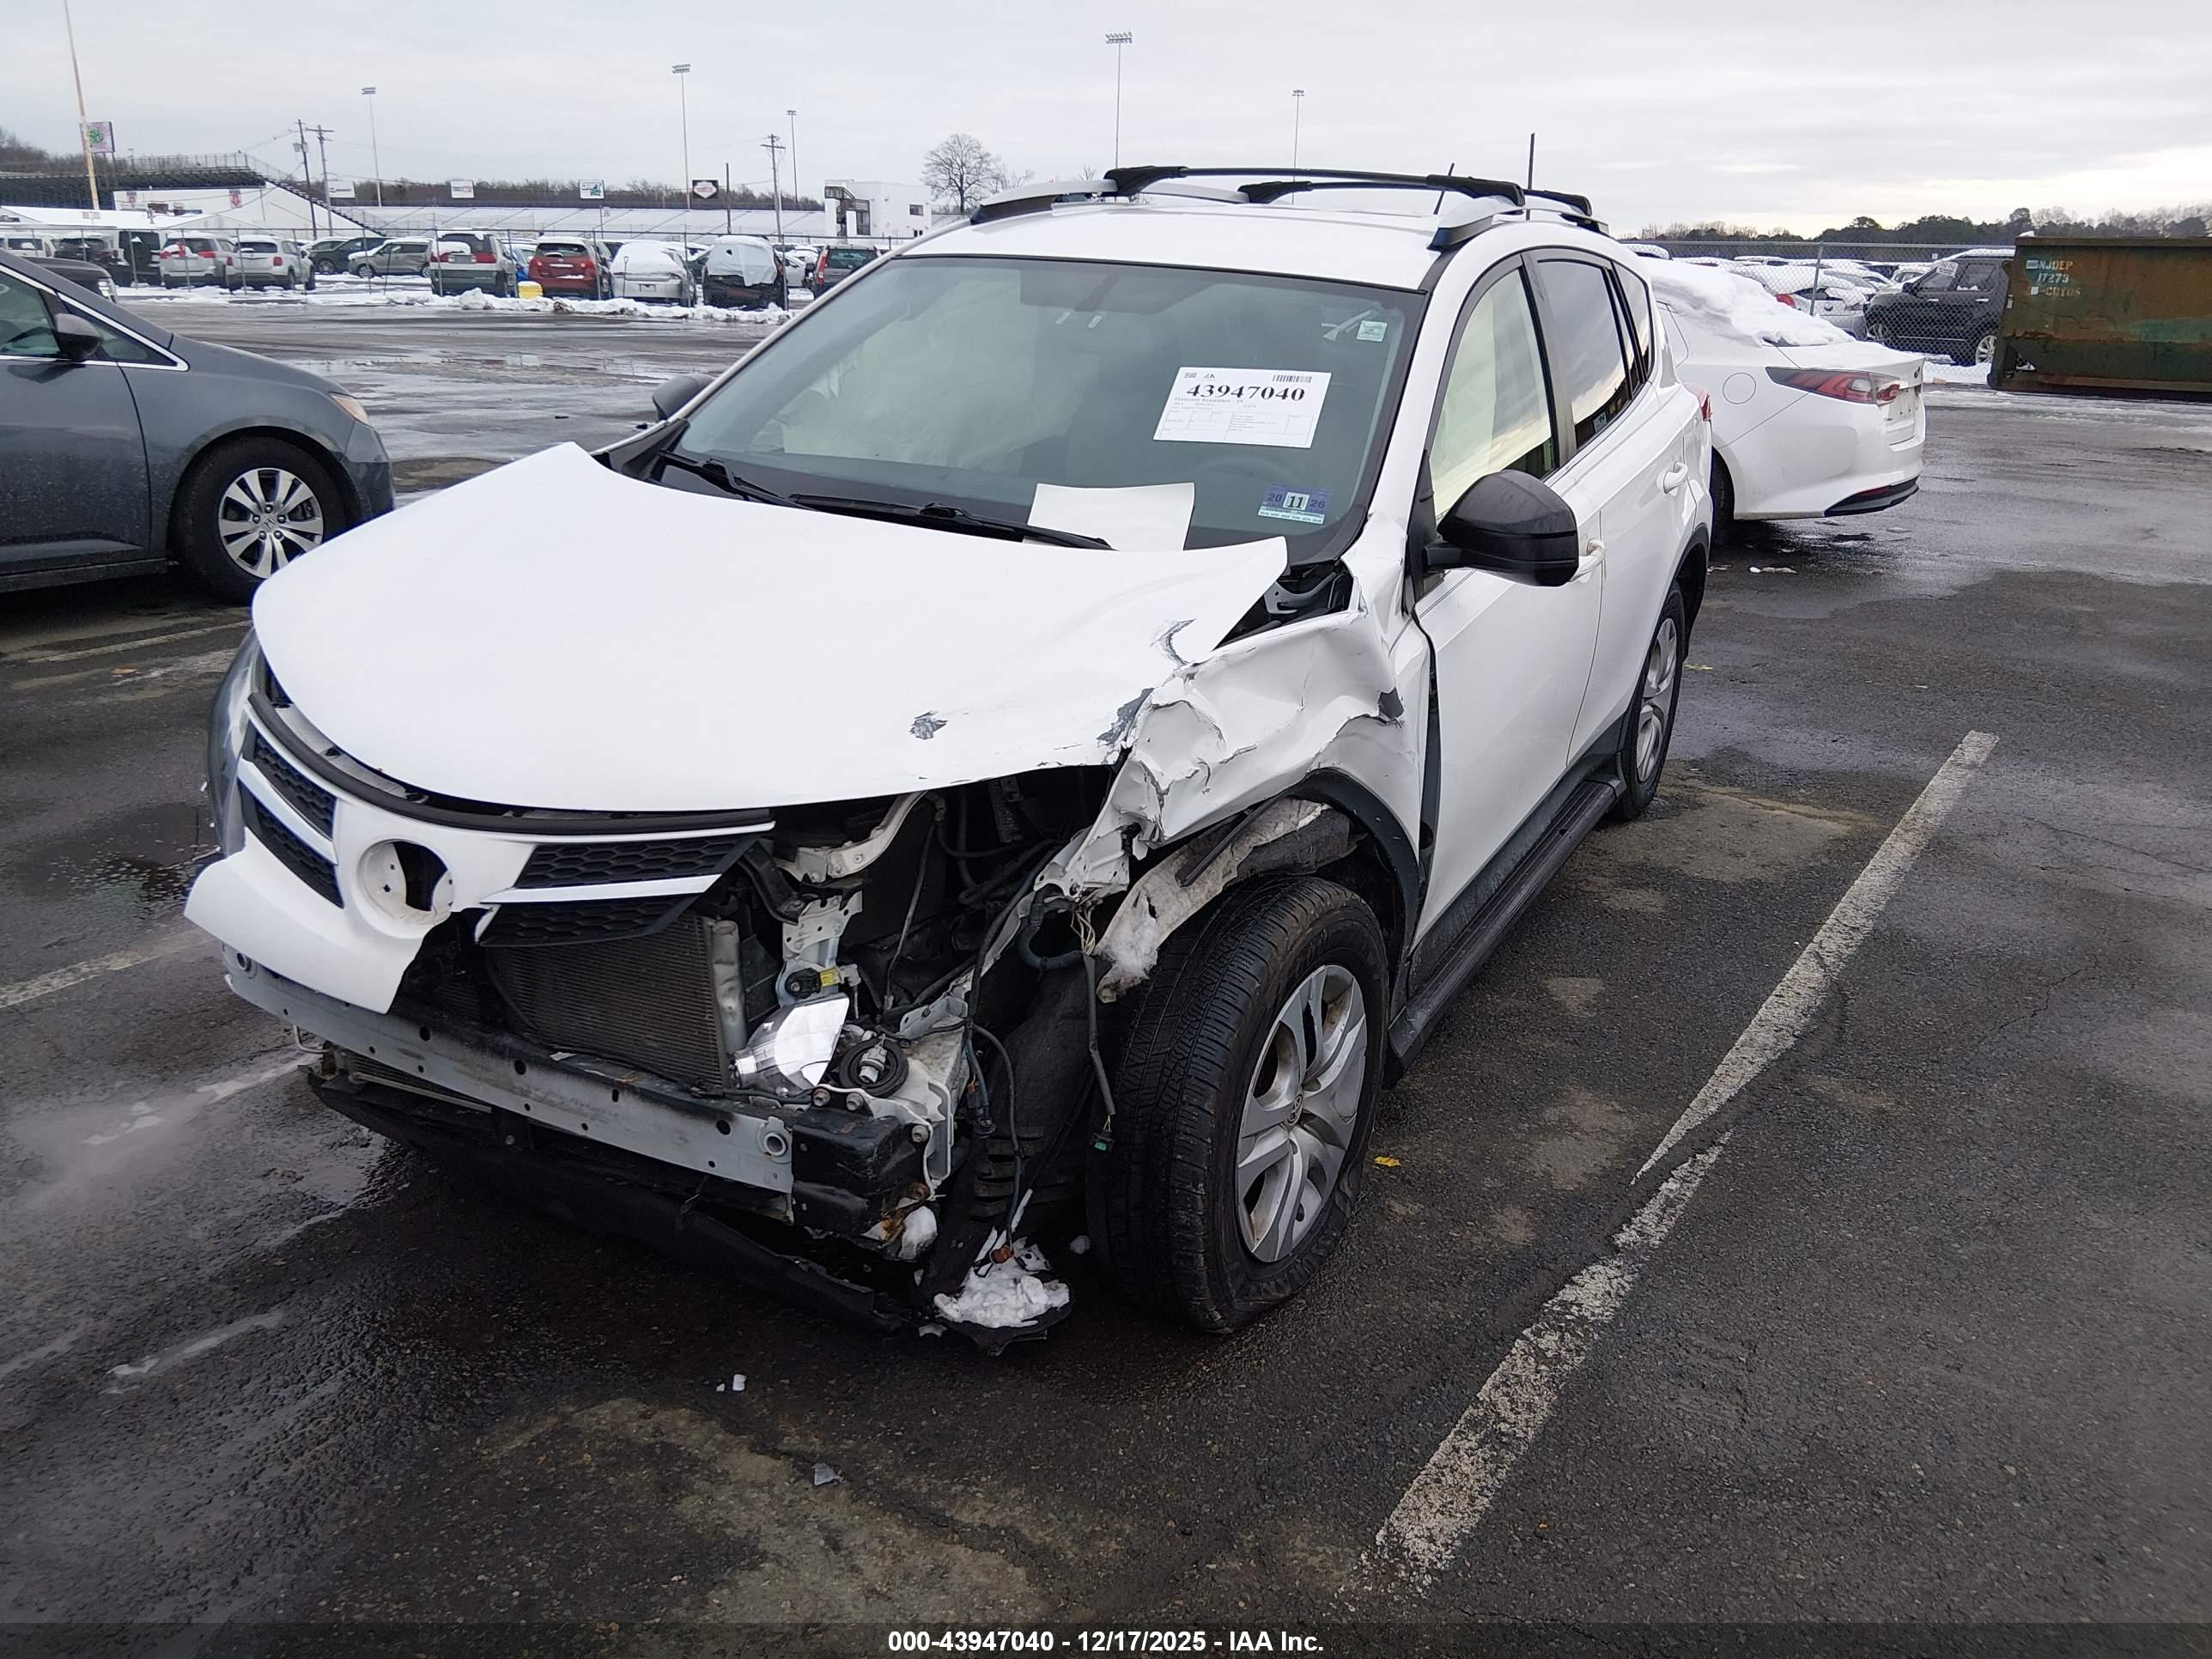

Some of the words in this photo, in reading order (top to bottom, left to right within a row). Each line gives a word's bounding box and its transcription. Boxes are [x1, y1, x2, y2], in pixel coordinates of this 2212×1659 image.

[2039, 260, 2074, 270] NJDEP
[1186, 384, 1305, 402] 43947040
[1267, 493, 1283, 502] 20
[1287, 495, 1304, 508] 11
[1310, 499, 1326, 508] 26
